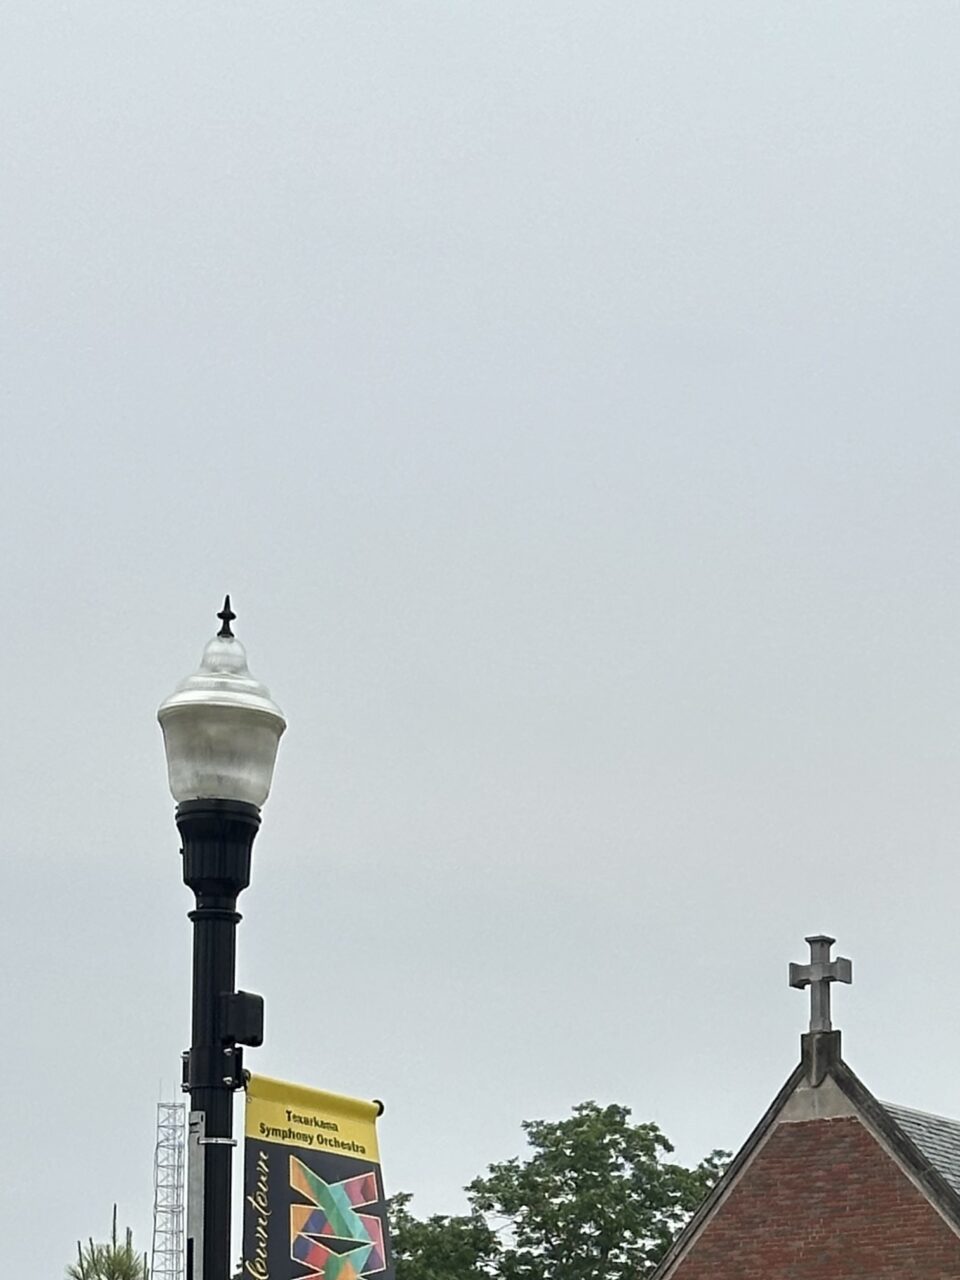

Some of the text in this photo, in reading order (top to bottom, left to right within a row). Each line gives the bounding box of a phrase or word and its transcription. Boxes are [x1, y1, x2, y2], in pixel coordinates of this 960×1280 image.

[285, 1109, 339, 1132] Texarkana
[259, 1122, 366, 1154] Symphony Orchestra
